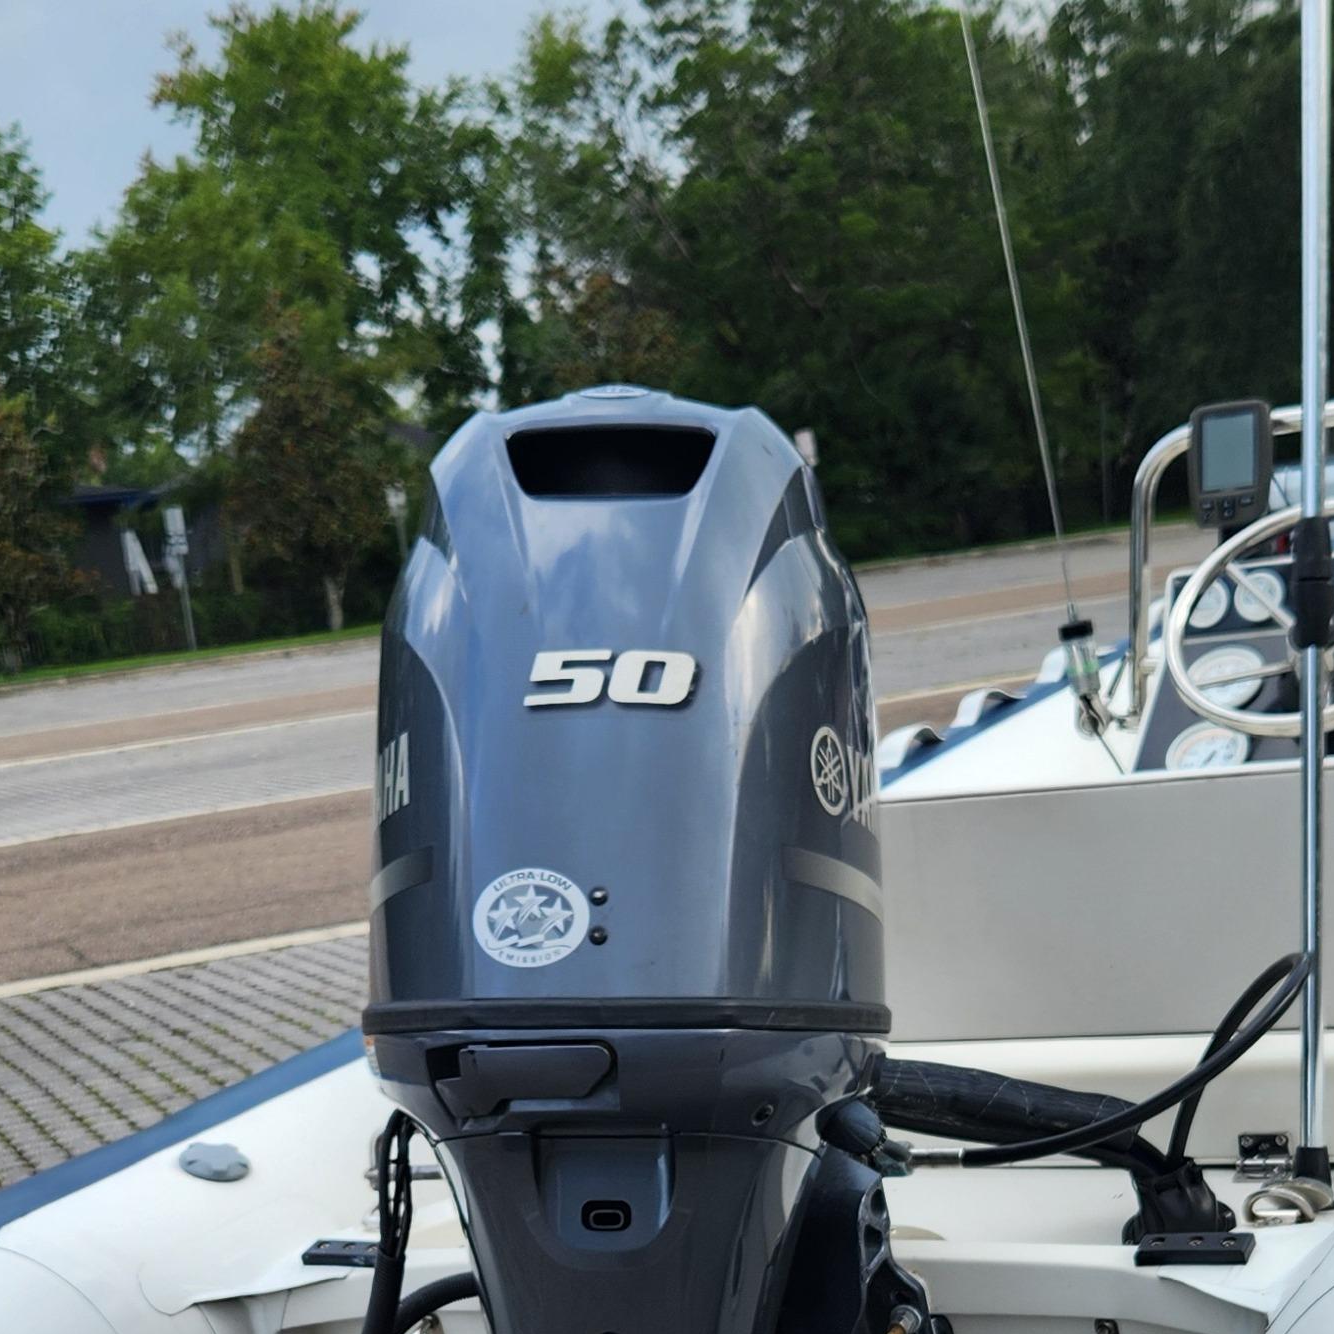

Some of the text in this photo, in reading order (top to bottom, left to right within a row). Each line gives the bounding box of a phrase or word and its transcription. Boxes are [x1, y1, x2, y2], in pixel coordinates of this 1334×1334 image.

[523, 649, 696, 706] 50
[493, 871, 572, 892] ULTRA LOW
[498, 949, 563, 964] EMISSION
